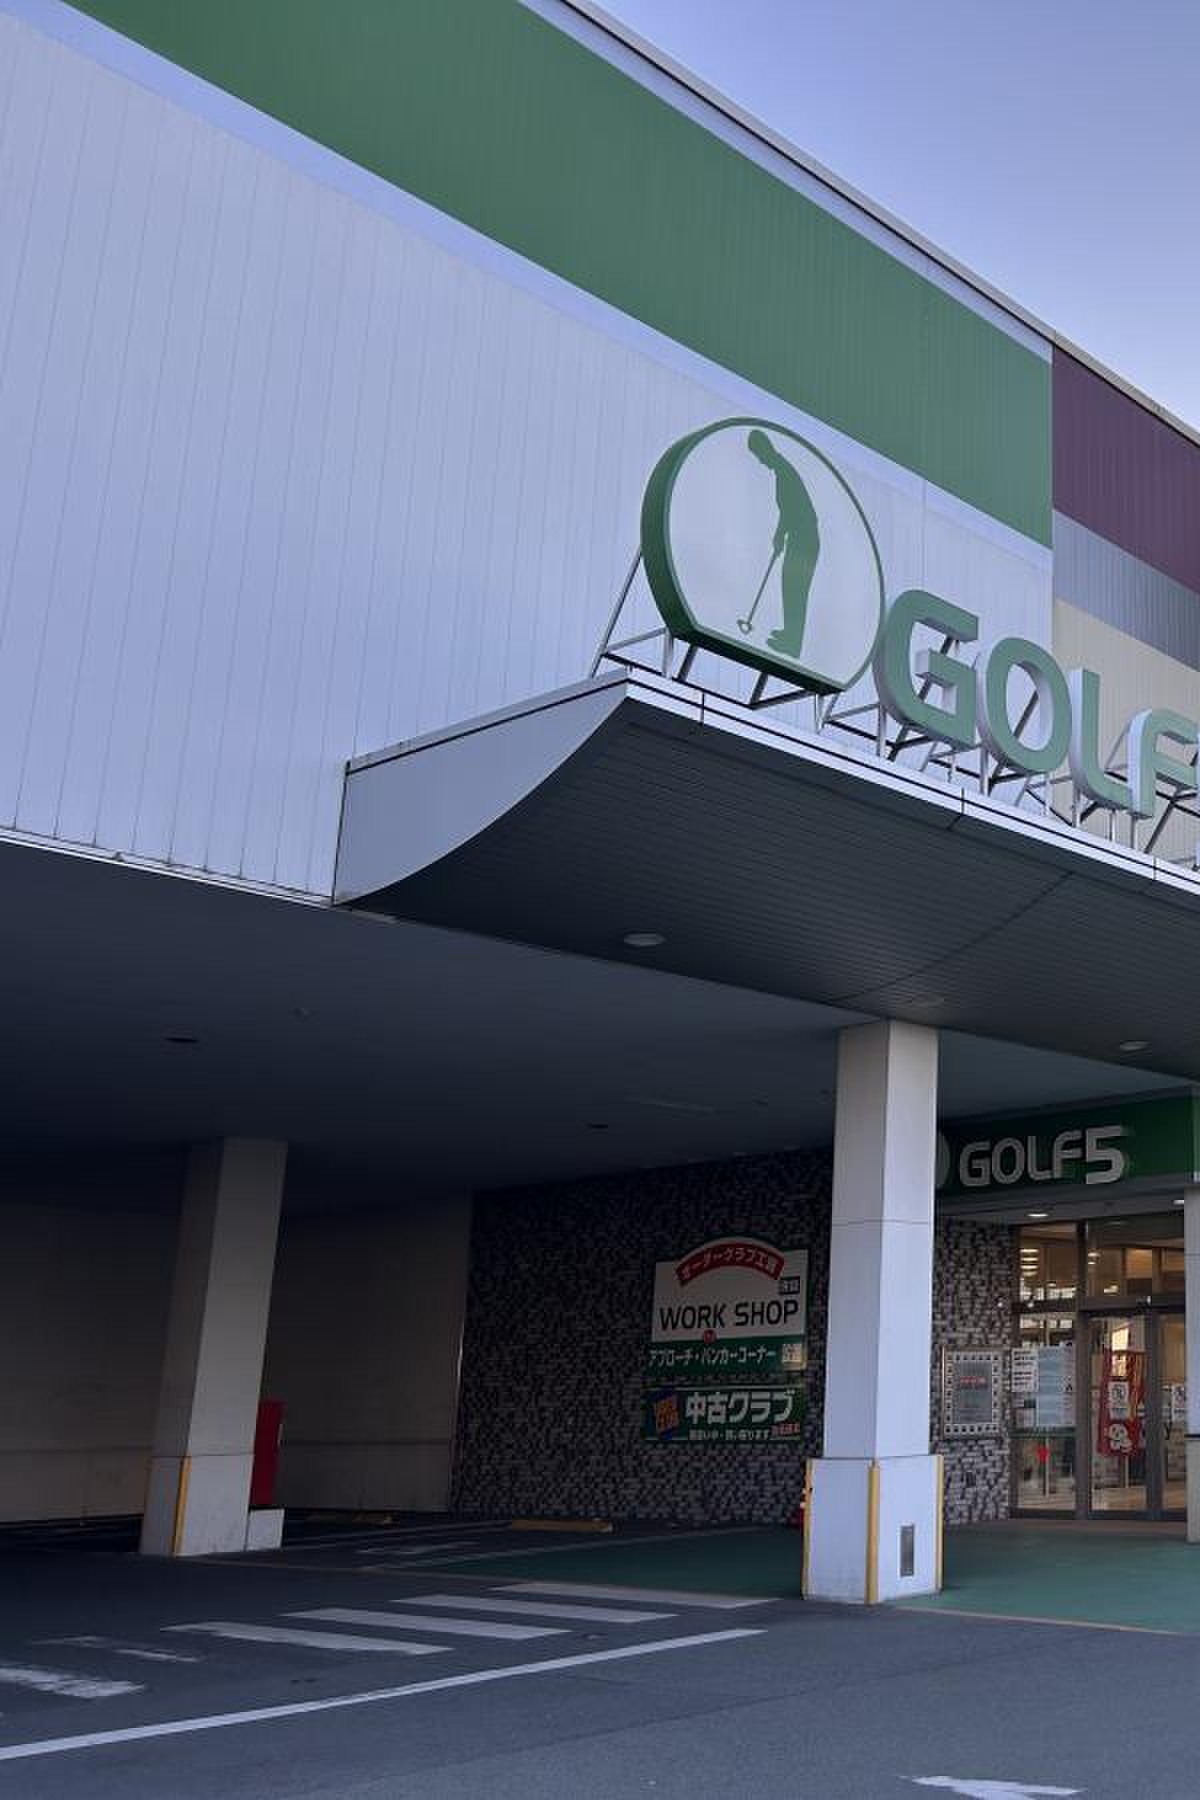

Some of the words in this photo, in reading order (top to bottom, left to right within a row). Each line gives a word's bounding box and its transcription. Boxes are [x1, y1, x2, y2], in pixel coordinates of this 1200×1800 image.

[959, 1125, 1125, 1187] GOLF5
[659, 1304, 727, 1331] WORK
[734, 1299, 799, 1327] SHOP
[684, 1388, 796, 1425] 中古クラブ
